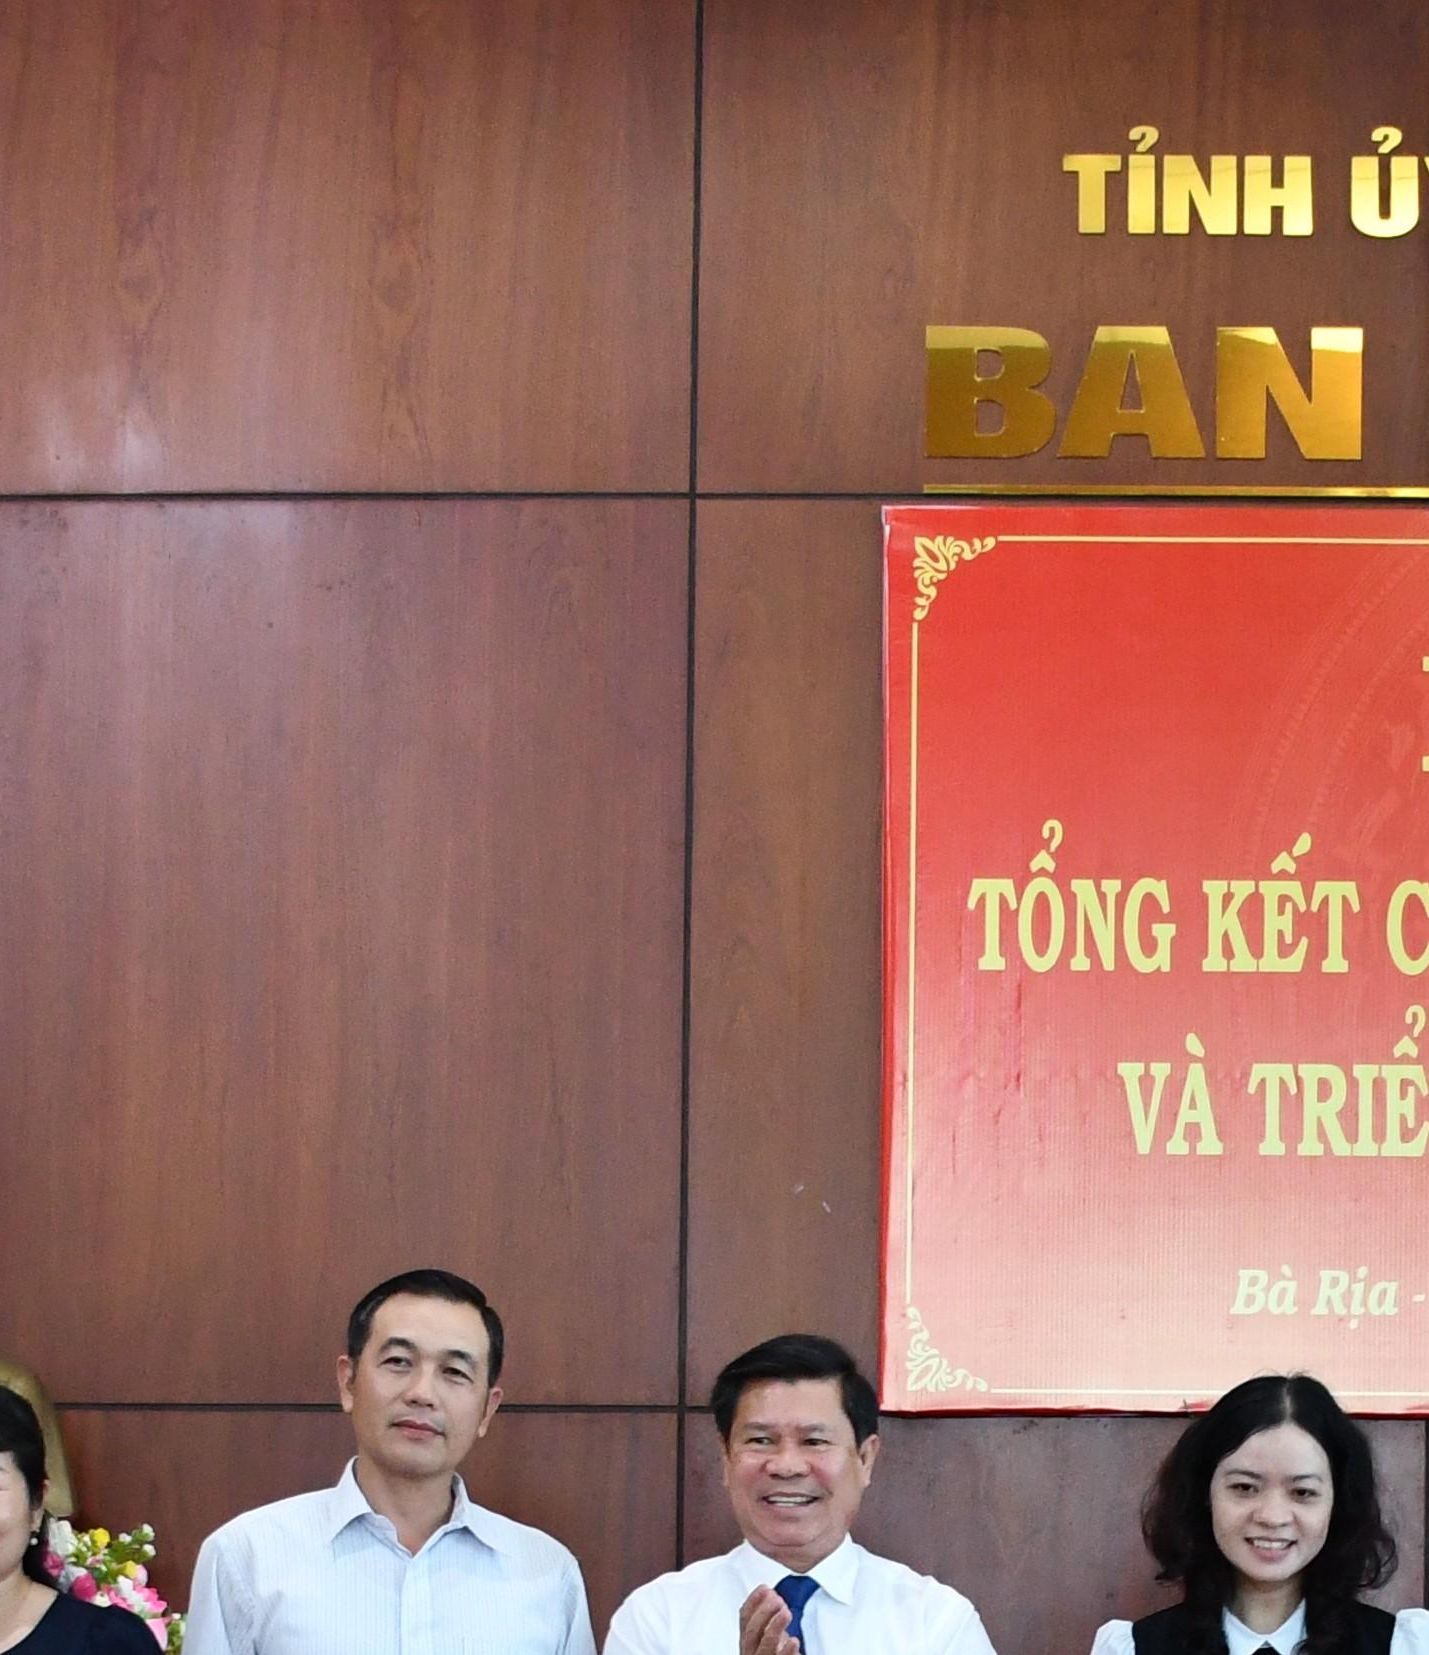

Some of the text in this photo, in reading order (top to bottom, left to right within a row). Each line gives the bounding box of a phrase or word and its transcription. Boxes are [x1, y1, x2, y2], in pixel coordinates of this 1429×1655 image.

[1063, 124, 1314, 236] TỈNH
[924, 324, 1365, 461] BAN
[966, 819, 1177, 974] TỔNG
[1201, 831, 1361, 974] KẾT
[1117, 1033, 1224, 1156] VÀ
[1230, 1265, 1298, 1316] Bà
[1311, 1266, 1399, 1329] Rịa
